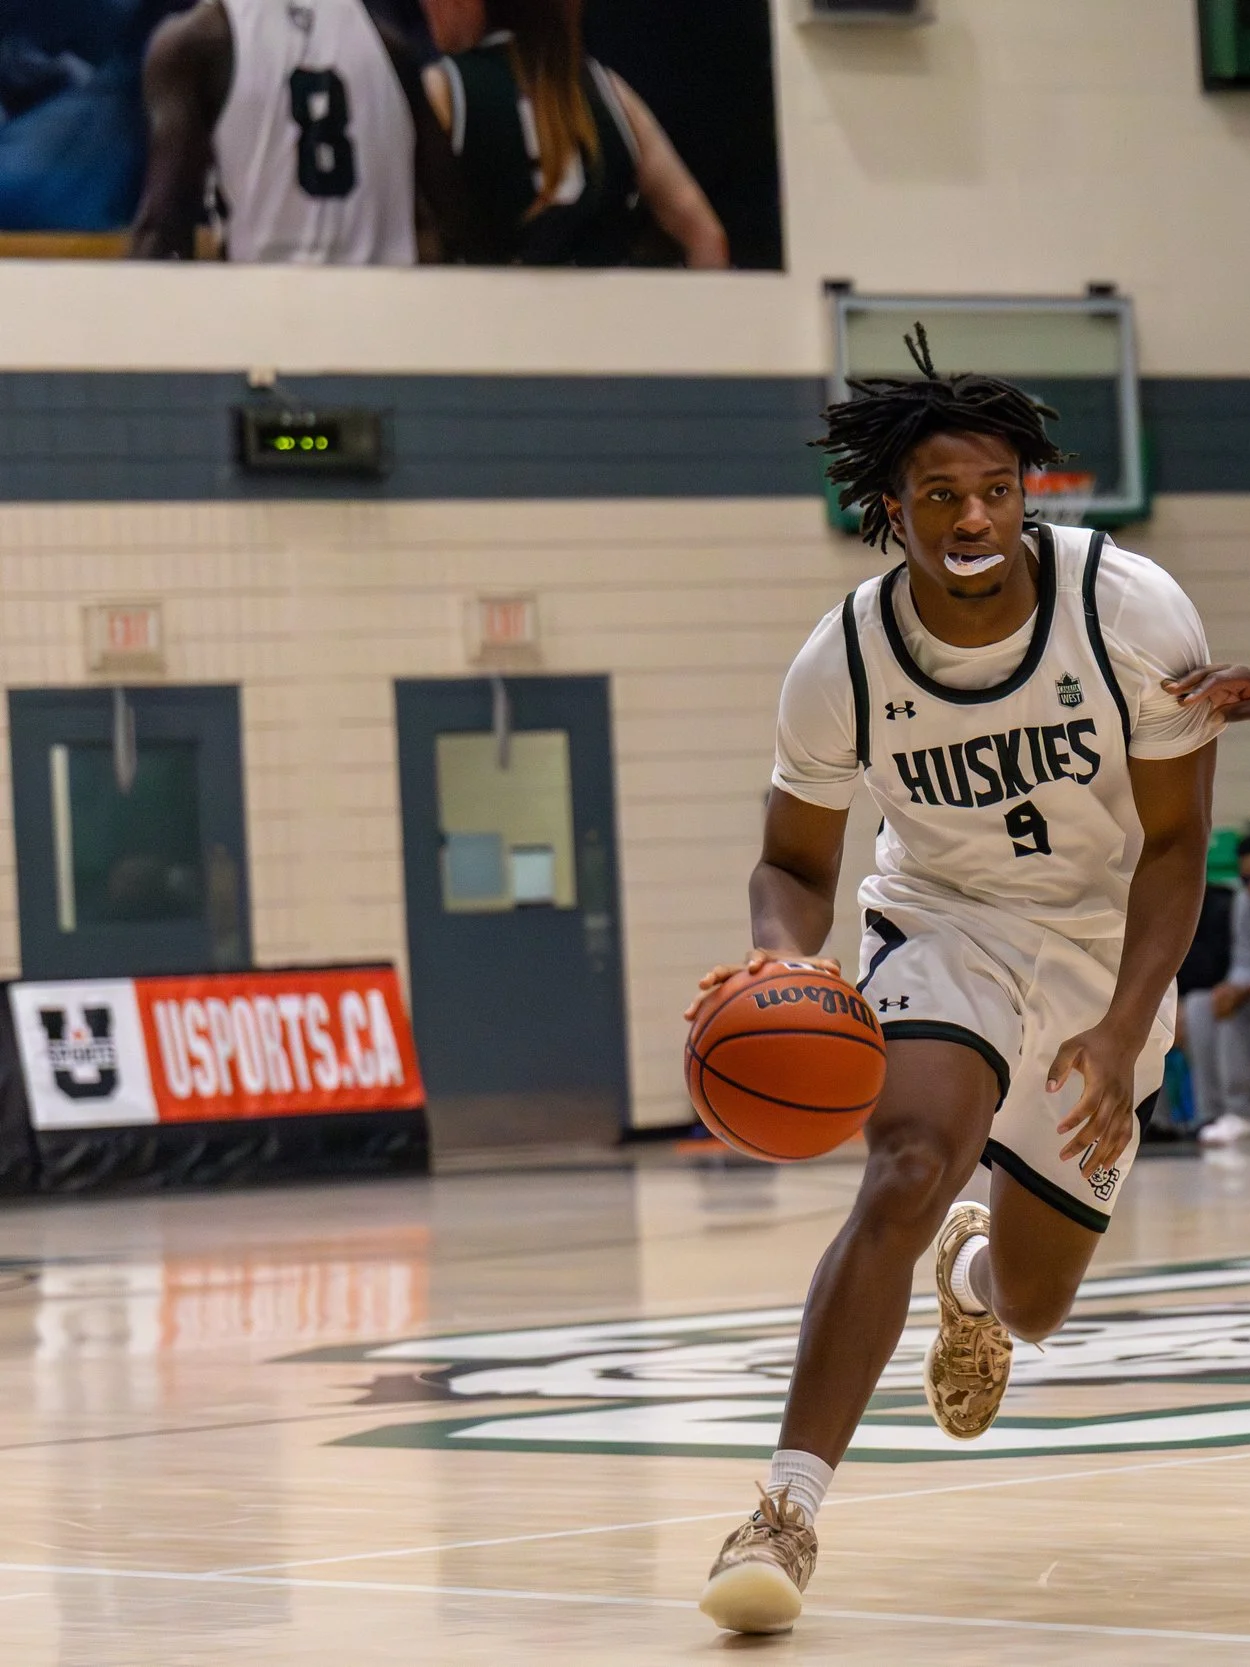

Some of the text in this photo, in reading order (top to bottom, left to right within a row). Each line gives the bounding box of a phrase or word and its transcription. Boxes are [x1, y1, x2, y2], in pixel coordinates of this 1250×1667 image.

[290, 69, 355, 197] 8
[1060, 693, 1081, 704] WEST
[892, 718, 1101, 808] HUSKIES
[1003, 800, 1052, 857] 9
[152, 989, 404, 1099] USPORTS.CA
[754, 986, 877, 1034] Wilson
